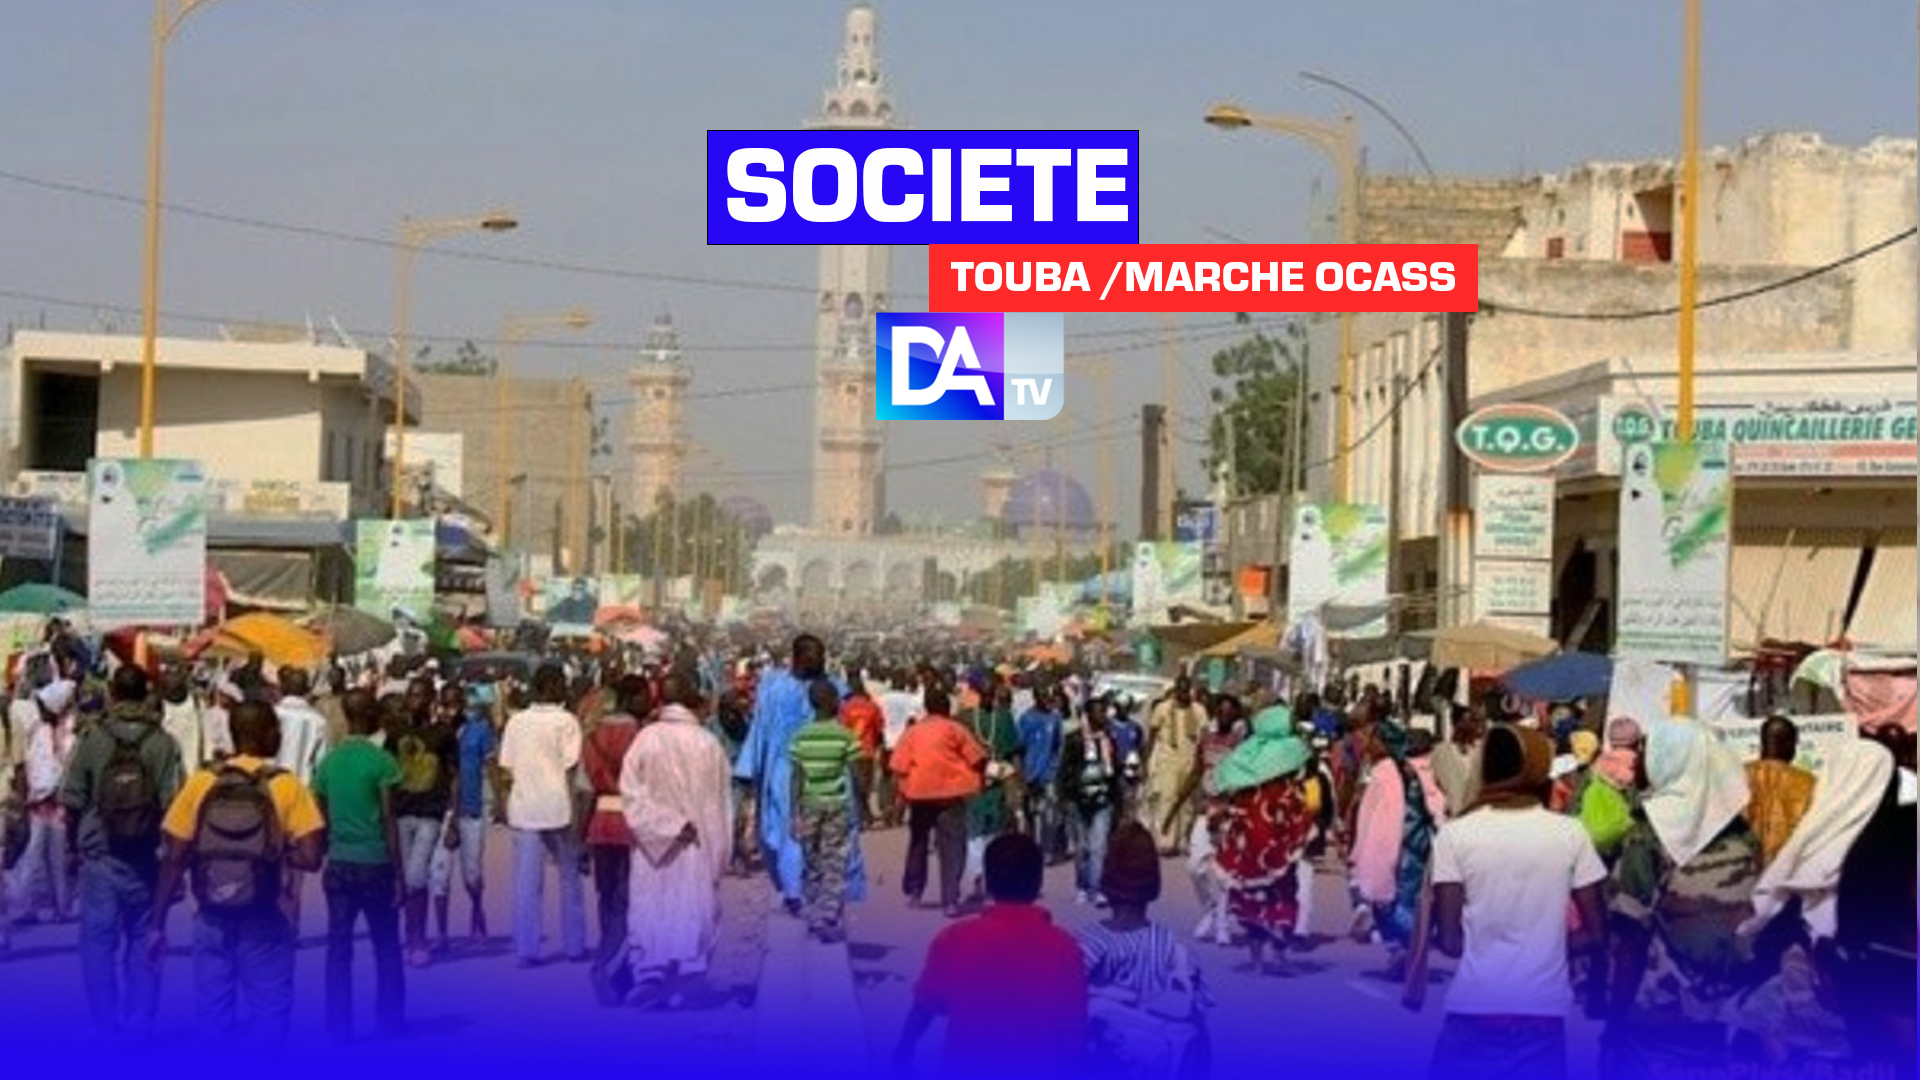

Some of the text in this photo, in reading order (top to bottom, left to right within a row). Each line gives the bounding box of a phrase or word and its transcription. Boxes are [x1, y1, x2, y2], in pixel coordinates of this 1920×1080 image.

[1470, 425, 1565, 453] T.Q.G.
[1660, 418, 1726, 441] TUBA
[1733, 417, 1885, 443] QUINCAILLERIE
